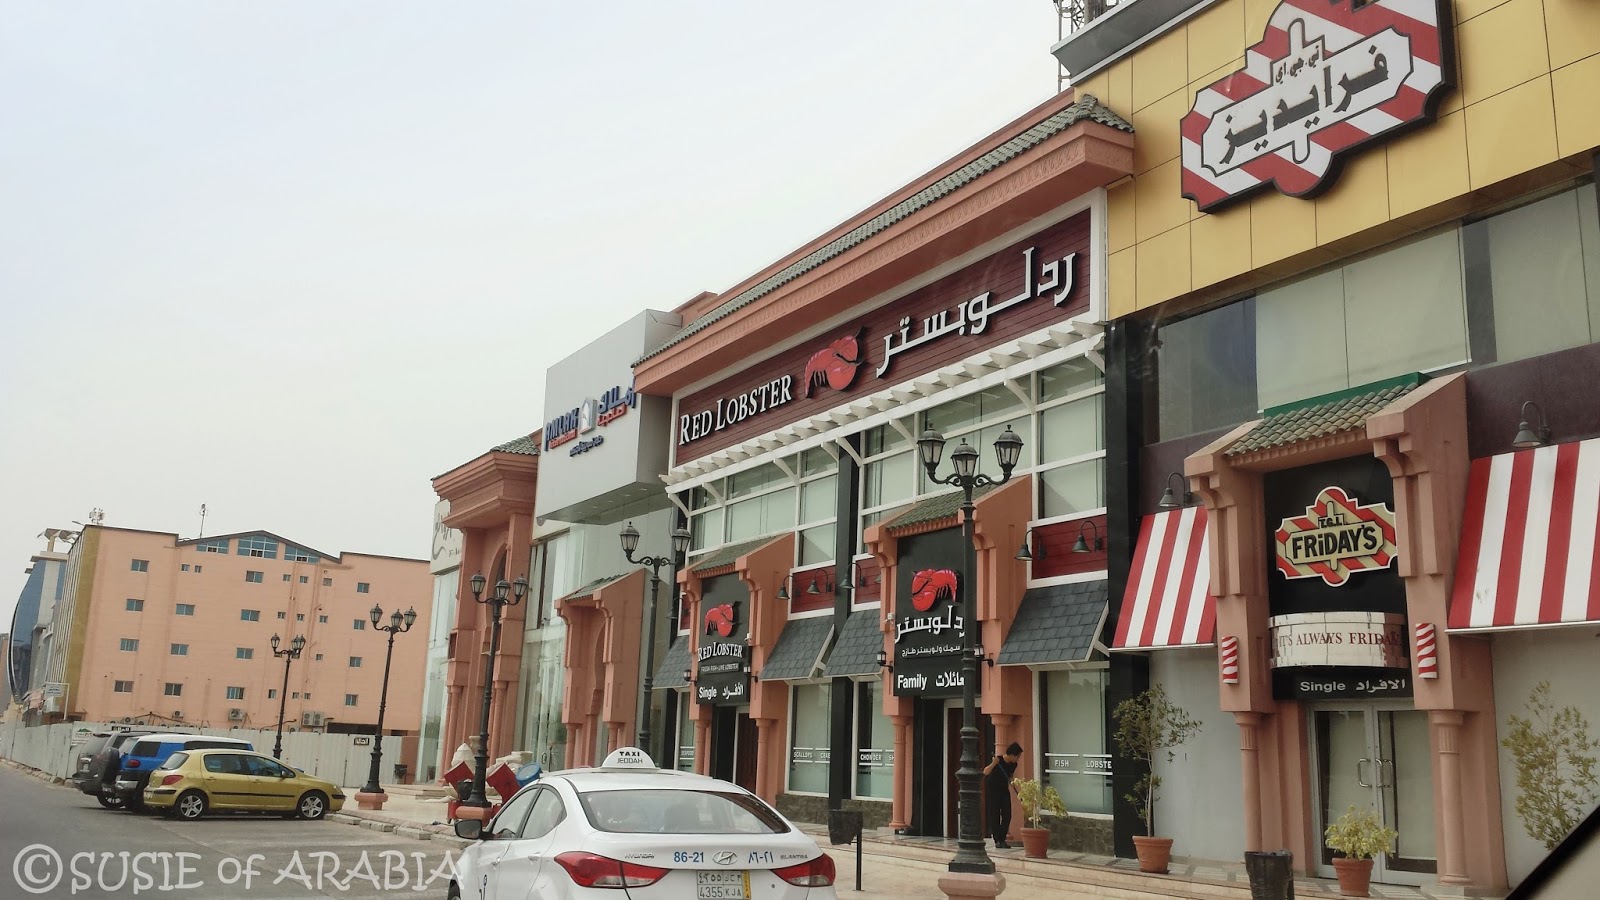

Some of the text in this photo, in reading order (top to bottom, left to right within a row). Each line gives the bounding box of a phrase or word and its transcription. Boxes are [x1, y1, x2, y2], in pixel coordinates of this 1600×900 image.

[1219, 45, 1388, 164] فرايديز
[679, 374, 792, 445] RED LOBSTER
[1319, 516, 1343, 528] T.G.I.
[1296, 632, 1343, 646] ALWAYS
[697, 642, 743, 661] RED LOBSTER
[897, 674, 927, 691] Family
[1300, 681, 1346, 693] Single
[699, 686, 718, 700] Single
[673, 851, 704, 863] 86-21
[700, 886, 742, 898] 4355 KJA
